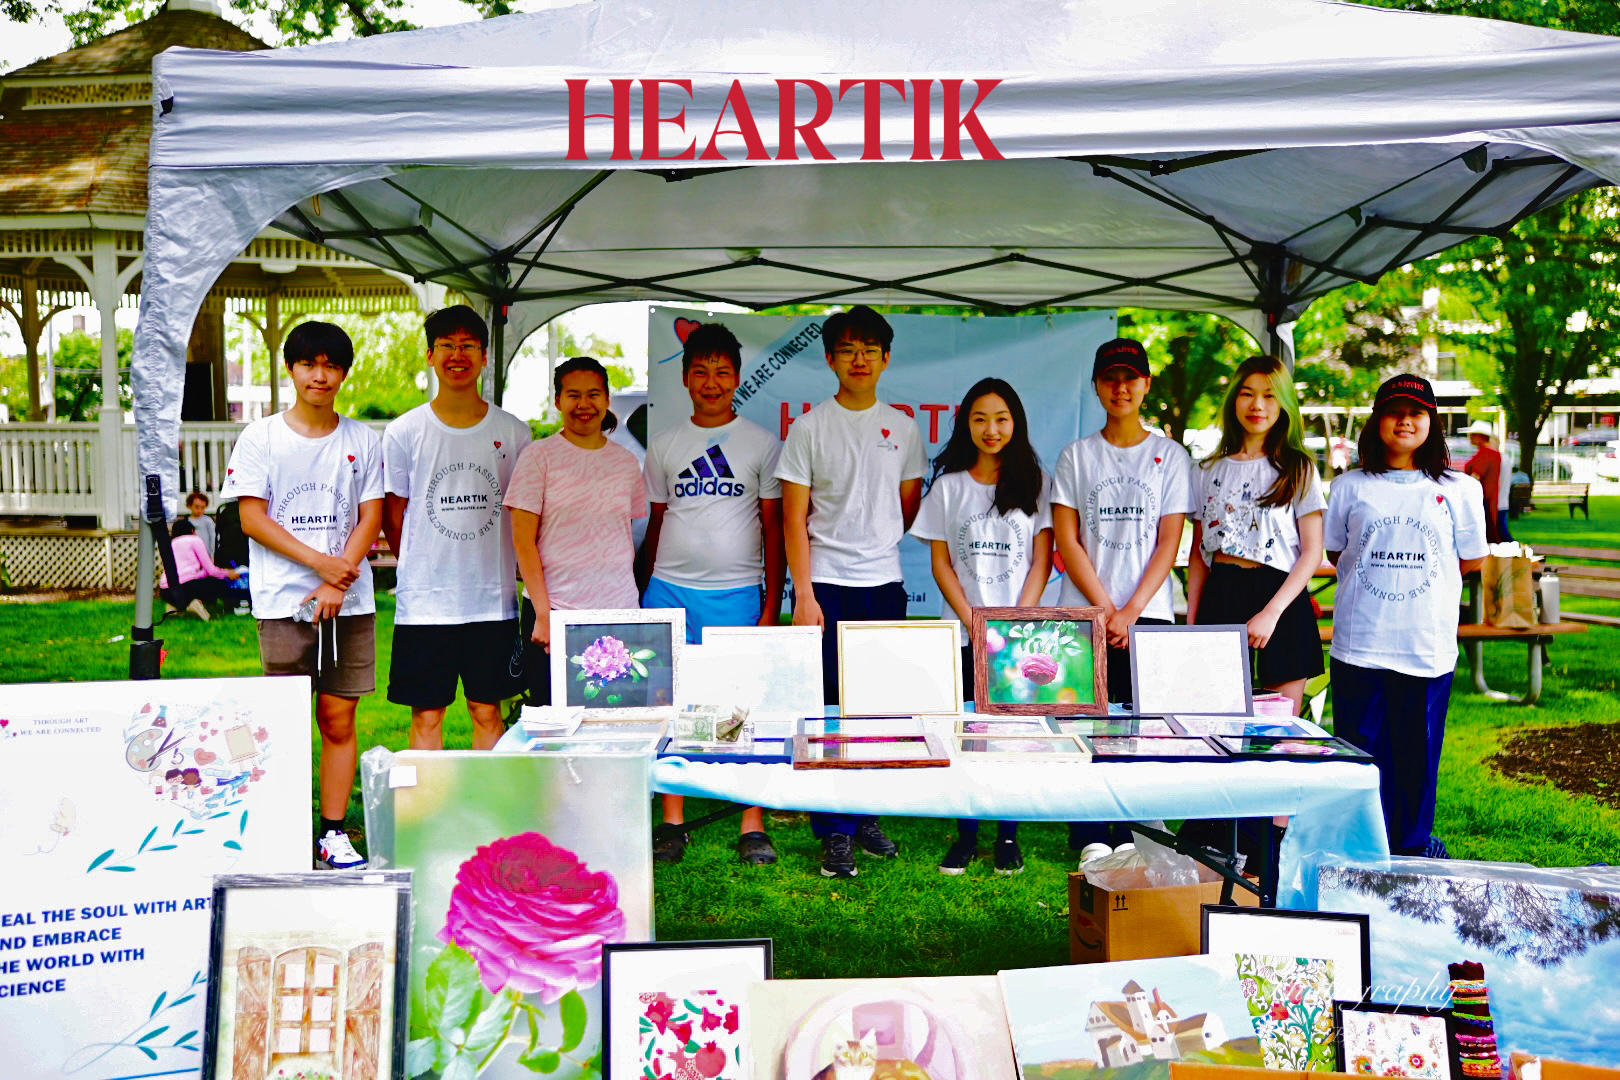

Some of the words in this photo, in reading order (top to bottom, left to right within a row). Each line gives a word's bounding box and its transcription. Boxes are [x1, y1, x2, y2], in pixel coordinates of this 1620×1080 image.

[736, 381, 757, 401] WE
[751, 363, 775, 388] ARE
[768, 322, 823, 370] CONNECTED
[426, 462, 465, 500] THROUGH
[468, 462, 502, 497] PASSION
[674, 477, 745, 498] adidas
[277, 482, 316, 519] THROUGH
[320, 483, 351, 517] PASSION
[440, 494, 488, 504] HEARTIK
[1086, 476, 1124, 510] THROUGH
[1128, 477, 1156, 510] PASSION
[291, 515, 337, 524] HEARTIK
[492, 501, 503, 518] WE
[1099, 506, 1145, 515] HEARTIK
[425, 501, 476, 541] CONNECTED
[478, 518, 494, 537] ARE
[958, 511, 992, 547] THROUGH
[968, 541, 1011, 551] HEARTIK
[1405, 516, 1438, 556] PASSION
[1370, 551, 1426, 562] HEARTIK
[1408, 579, 1431, 598] ARE
[33, 718, 72, 726] THROUGH
[1, 912, 36, 927] EAL
[42, 909, 76, 923] THE
[81, 905, 128, 920] SOUL
[134, 900, 177, 915] WITH
[0, 937, 26, 950] ND
[33, 927, 122, 947] EMBRACE
[0, 960, 20, 974] HE
[26, 953, 95, 971] WORLD
[100, 948, 145, 964] WITH
[0, 978, 66, 997] CIENCE
